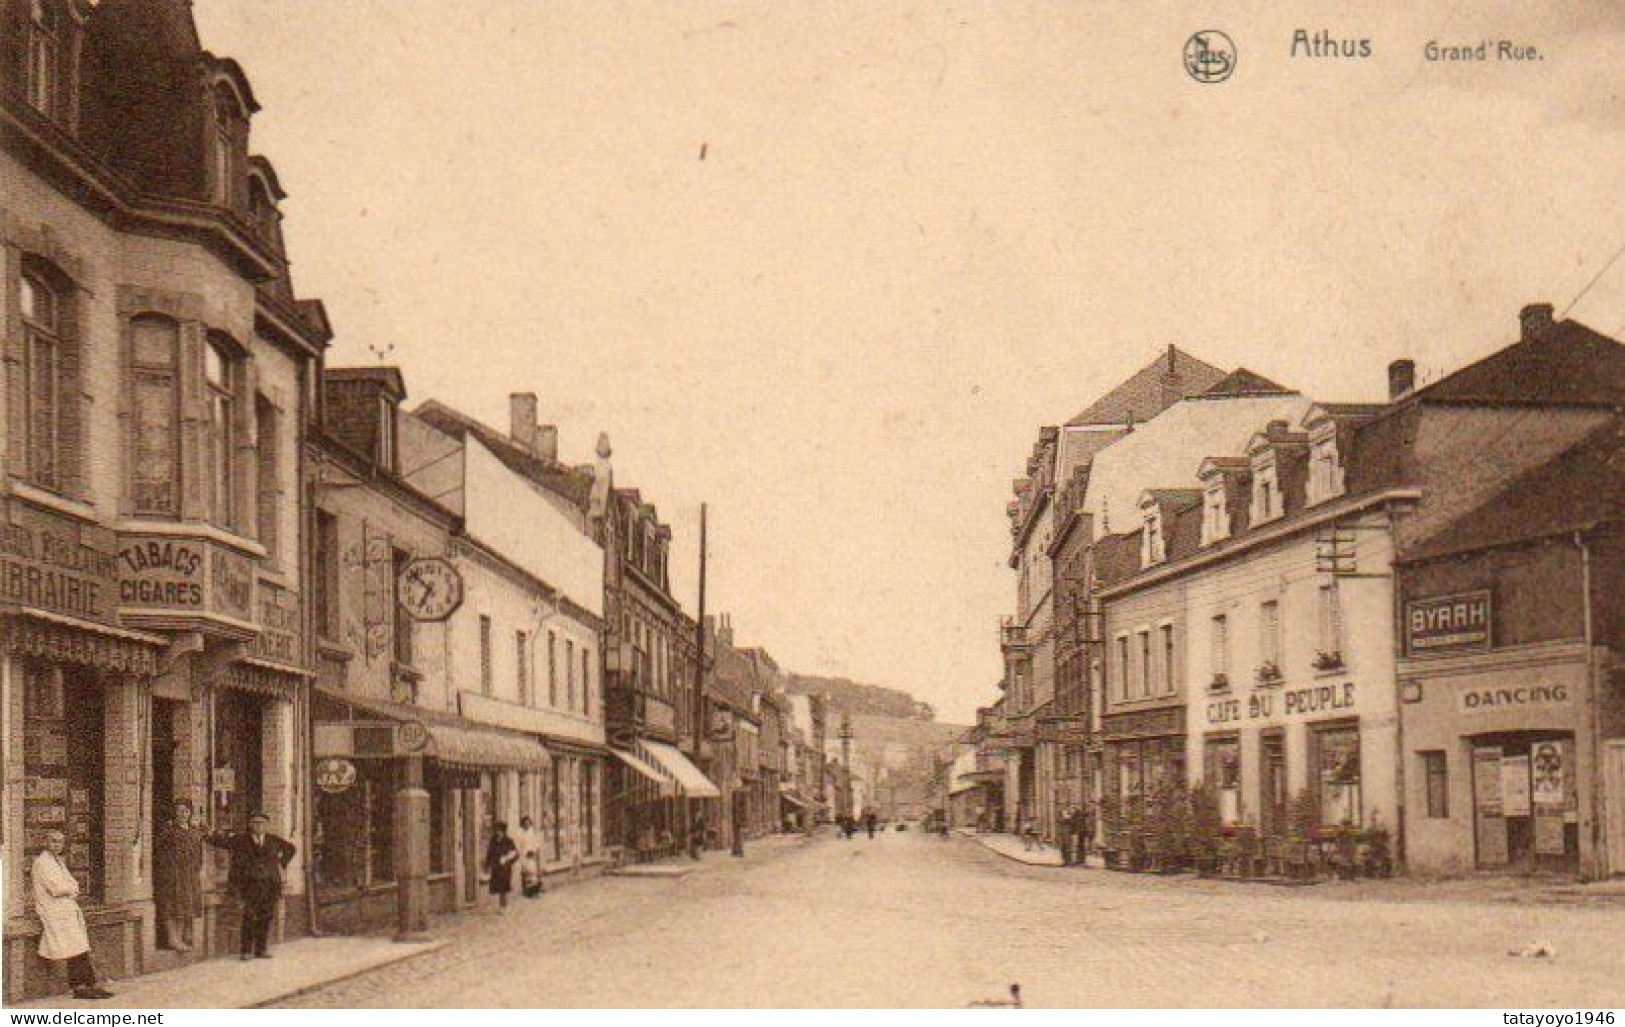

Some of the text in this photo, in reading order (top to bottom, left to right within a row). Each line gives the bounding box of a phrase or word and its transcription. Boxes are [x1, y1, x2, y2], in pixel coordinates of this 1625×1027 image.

[118, 541, 199, 576] TABACS
[1, 559, 102, 616] IBRAIRIE
[120, 578, 201, 605] CIGARES
[1285, 682, 1355, 715] PEUPLE
[1464, 685, 1568, 709] DANCING
